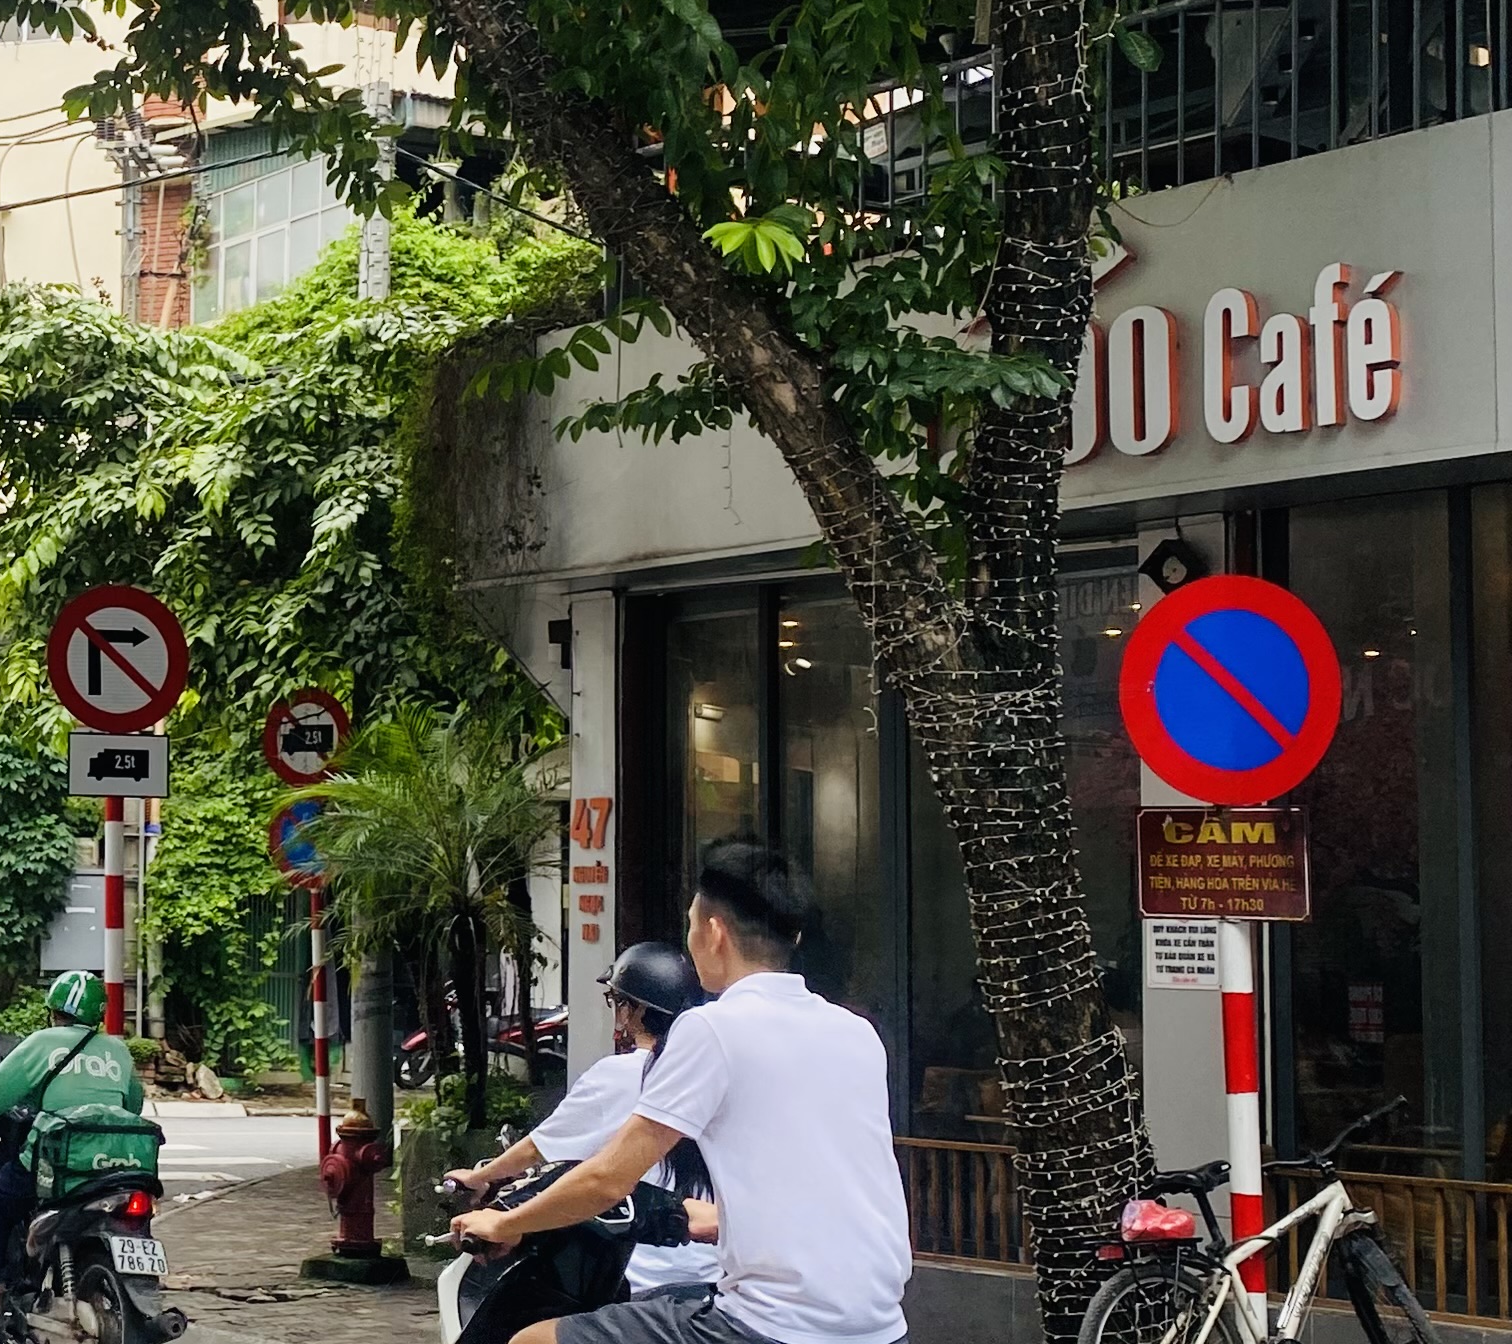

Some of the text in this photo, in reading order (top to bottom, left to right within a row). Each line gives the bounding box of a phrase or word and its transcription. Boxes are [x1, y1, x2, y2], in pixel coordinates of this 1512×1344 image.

[1203, 262, 1404, 444] Café
[570, 797, 613, 849] 47
[1165, 855, 1179, 867] XE
[1207, 855, 1220, 867] XE
[1201, 898, 1215, 910] 7h
[49, 1047, 122, 1082] Grab
[119, 1238, 158, 1257] 29-E2
[118, 1255, 165, 1274] 786.20
